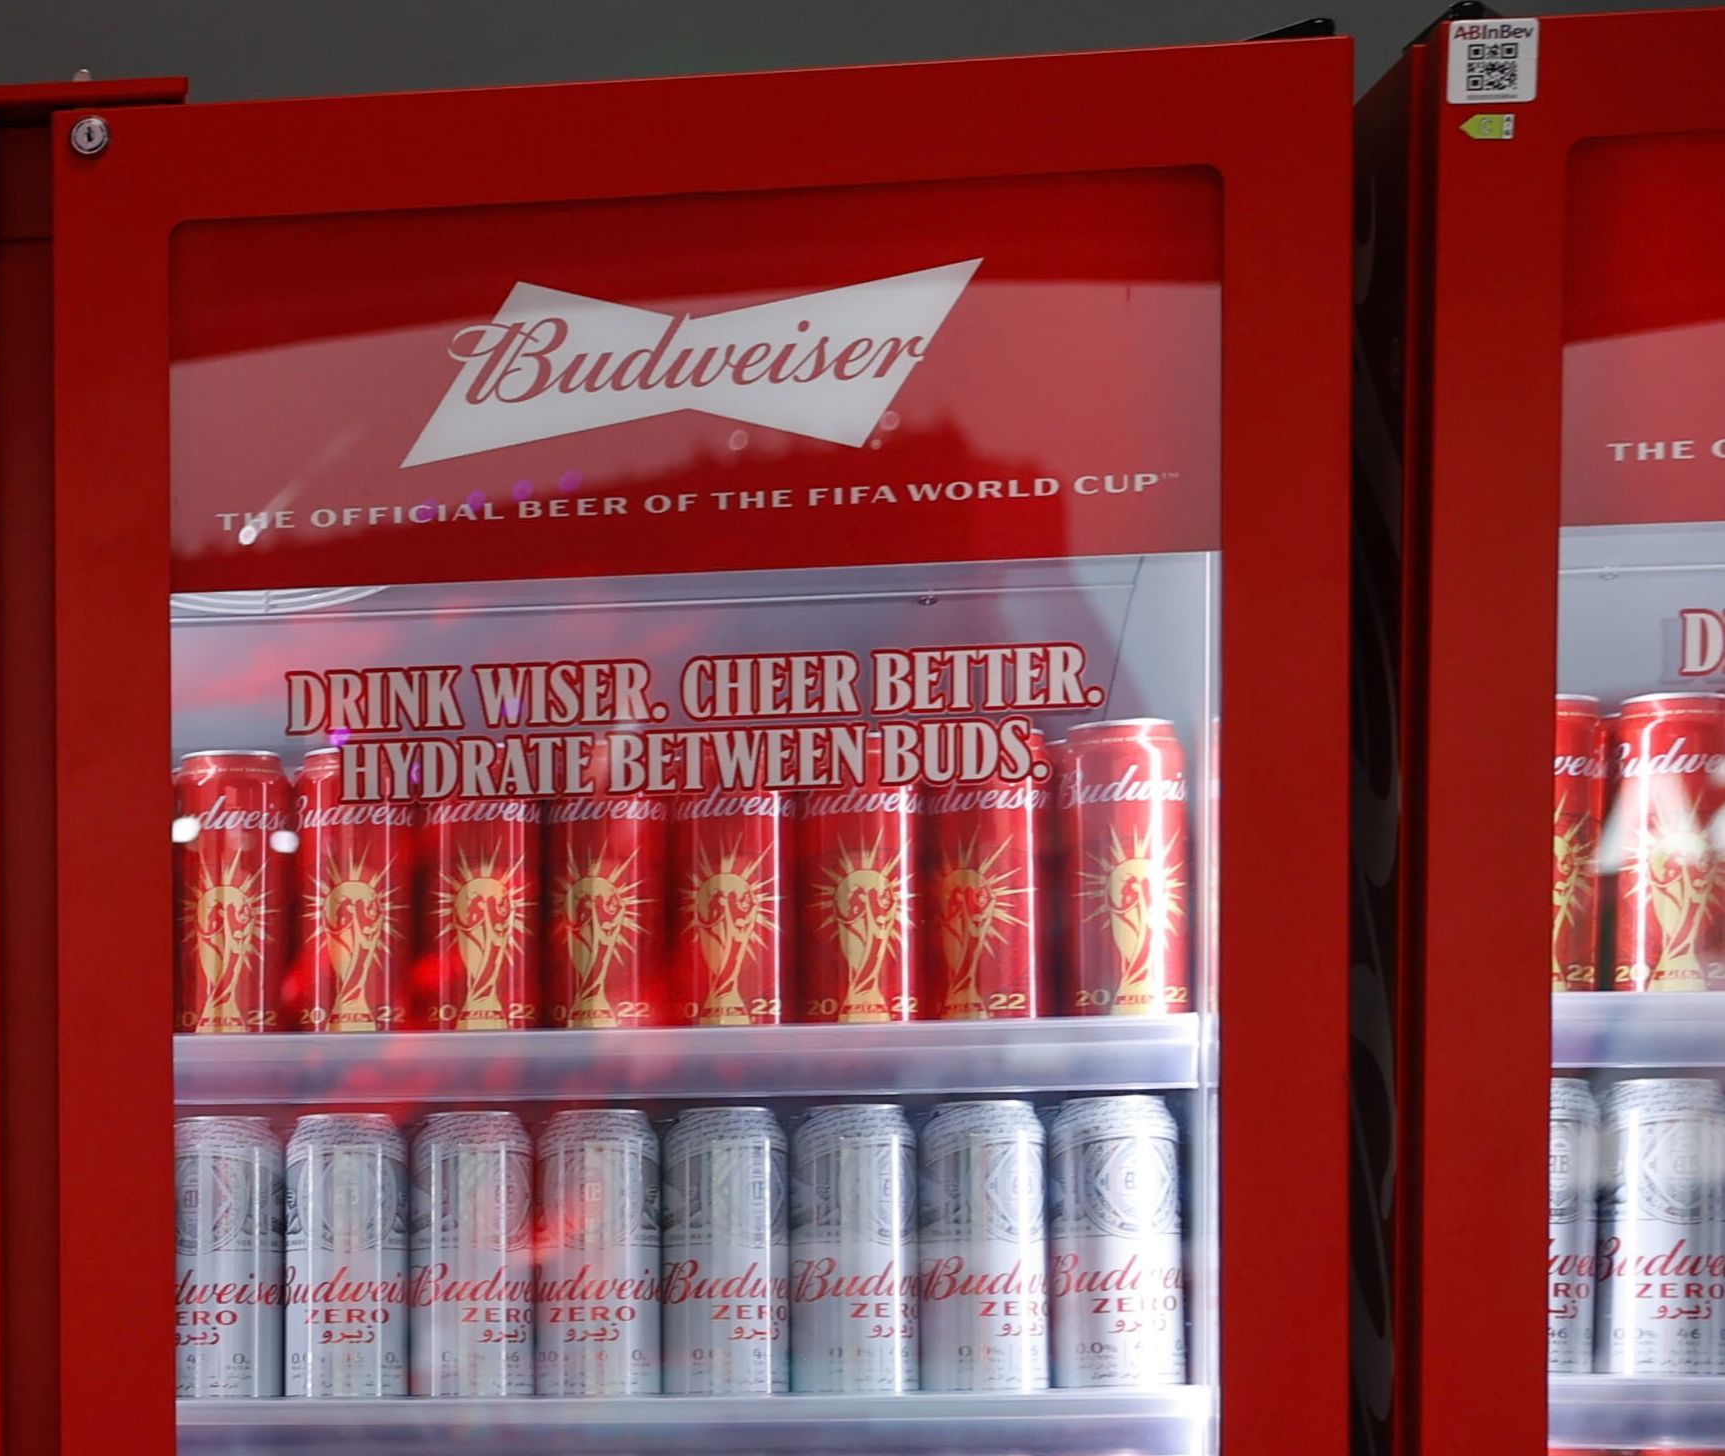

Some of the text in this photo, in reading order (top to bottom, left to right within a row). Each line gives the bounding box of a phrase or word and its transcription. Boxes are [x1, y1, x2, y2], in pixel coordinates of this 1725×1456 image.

[1454, 24, 1534, 40] ABInBev
[447, 312, 925, 406] Budweiser
[1608, 440, 1703, 462] THE
[216, 511, 294, 531] THE
[309, 501, 505, 528] OFFICIAL
[517, 495, 628, 520] BEER
[644, 491, 696, 514] OF
[710, 488, 793, 511] THE
[807, 483, 898, 507] FIFA
[907, 476, 1058, 502] WORLD
[286, 642, 1105, 737] DRINK WISER. CHEER BETTER.
[339, 718, 1050, 804] HYDRATE BETWEEN BUDS.
[989, 994, 1026, 1010] 22
